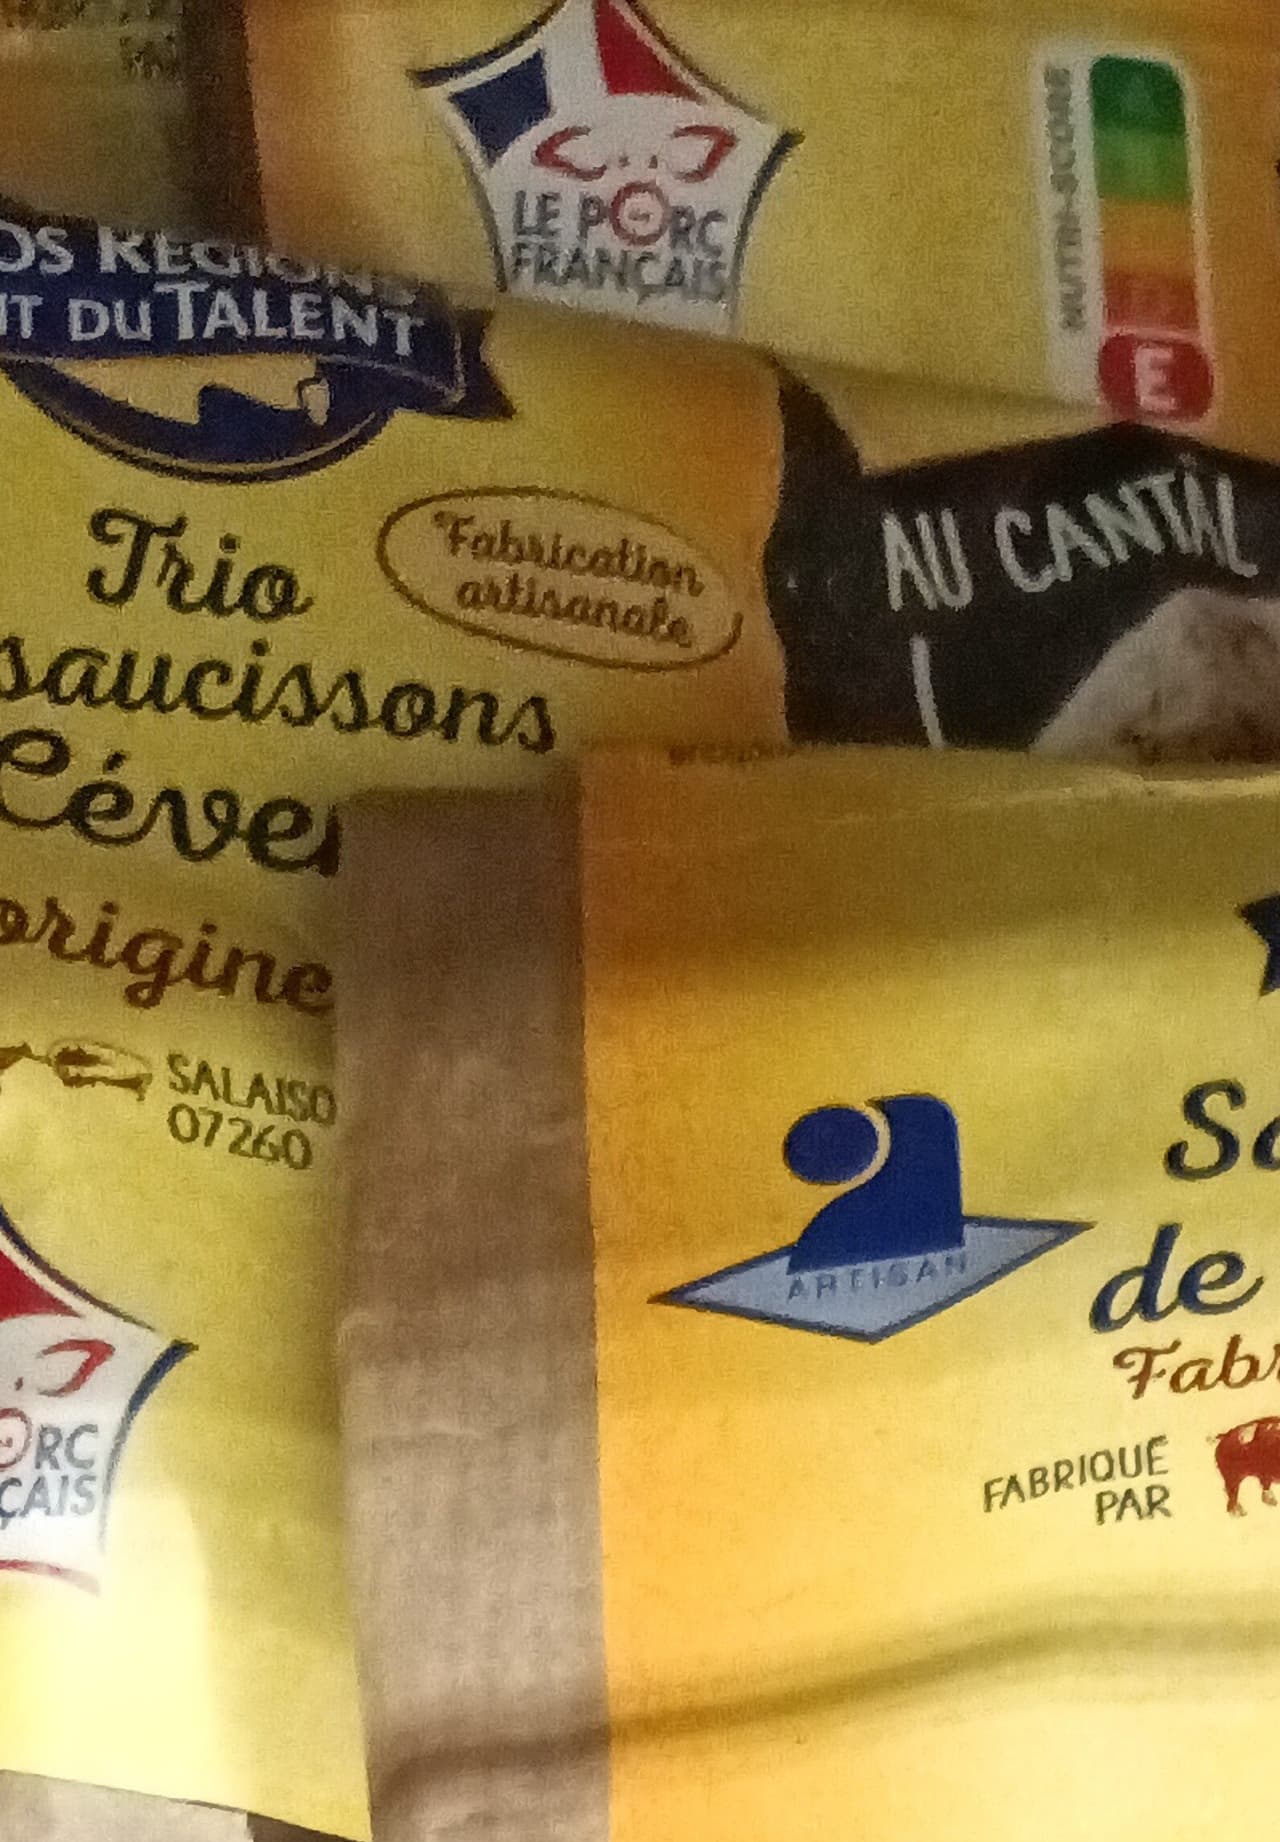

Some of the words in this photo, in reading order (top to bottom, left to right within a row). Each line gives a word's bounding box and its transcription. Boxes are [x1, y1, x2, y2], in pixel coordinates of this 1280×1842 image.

[513, 190, 560, 237] LE
[578, 181, 728, 258] PORC
[68, 298, 152, 341] DU
[154, 281, 424, 357] TALENT
[1134, 346, 1177, 412] E
[87, 507, 313, 622] Trio
[432, 510, 705, 598] Fabrication
[881, 509, 974, 613] AU
[996, 468, 1257, 593] CANTAL
[456, 573, 692, 649] artisanale
[0, 636, 557, 754] saucissons
[0, 897, 335, 1018] origine
[167, 1104, 312, 1170] 07260
[787, 1252, 967, 1304] ARTISAN
[1088, 1222, 1263, 1334] de
[1095, 1484, 1172, 1526] PAR
